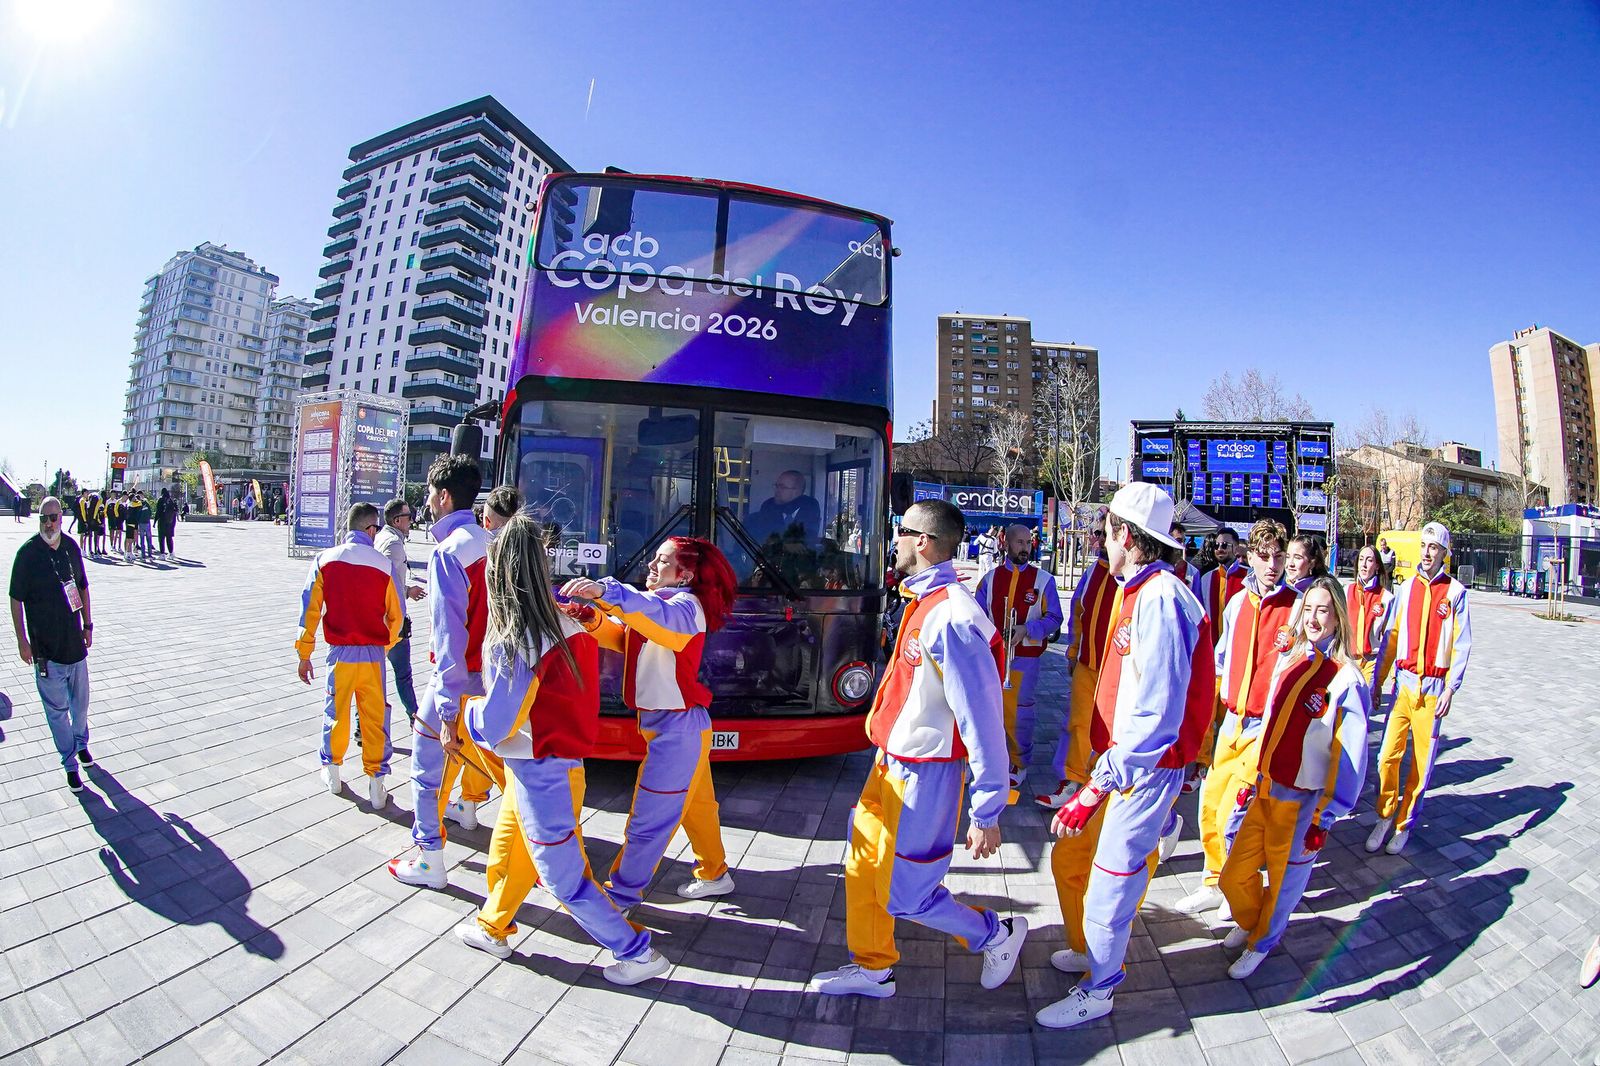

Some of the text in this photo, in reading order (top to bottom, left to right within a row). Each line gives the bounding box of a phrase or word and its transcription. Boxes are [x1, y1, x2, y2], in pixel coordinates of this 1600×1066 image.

[583, 232, 660, 258] acb
[848, 240, 884, 260] acb
[546, 250, 863, 327] Copa del Rey
[574, 302, 778, 341] Valencia 2026
[357, 424, 399, 438] COPA DEL REY
[1216, 442, 1256, 453] endesa
[1301, 445, 1324, 453] endesa
[117, 456, 127, 464] C2
[955, 489, 1032, 509] endesa
[1300, 517, 1323, 526] endesa
[583, 548, 602, 559] GO
